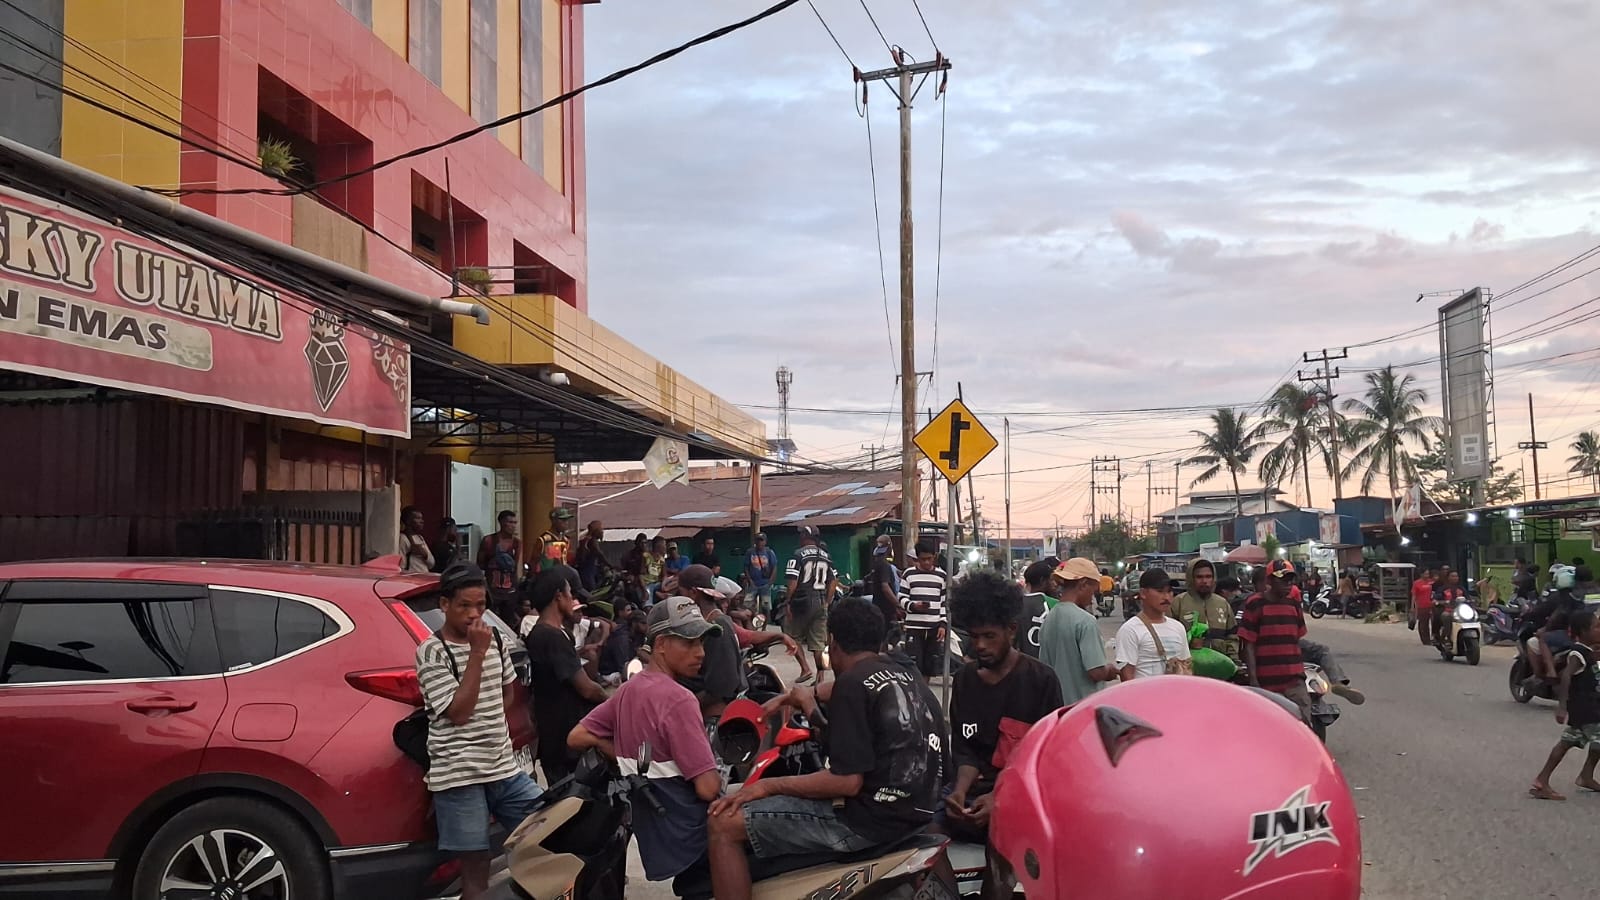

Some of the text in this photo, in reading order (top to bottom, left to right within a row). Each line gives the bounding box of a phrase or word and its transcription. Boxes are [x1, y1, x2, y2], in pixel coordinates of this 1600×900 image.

[0, 206, 282, 339] KY UTAMA
[38, 296, 167, 349] EMAS
[863, 669, 896, 690] STILL
[1249, 802, 1331, 842] INK
